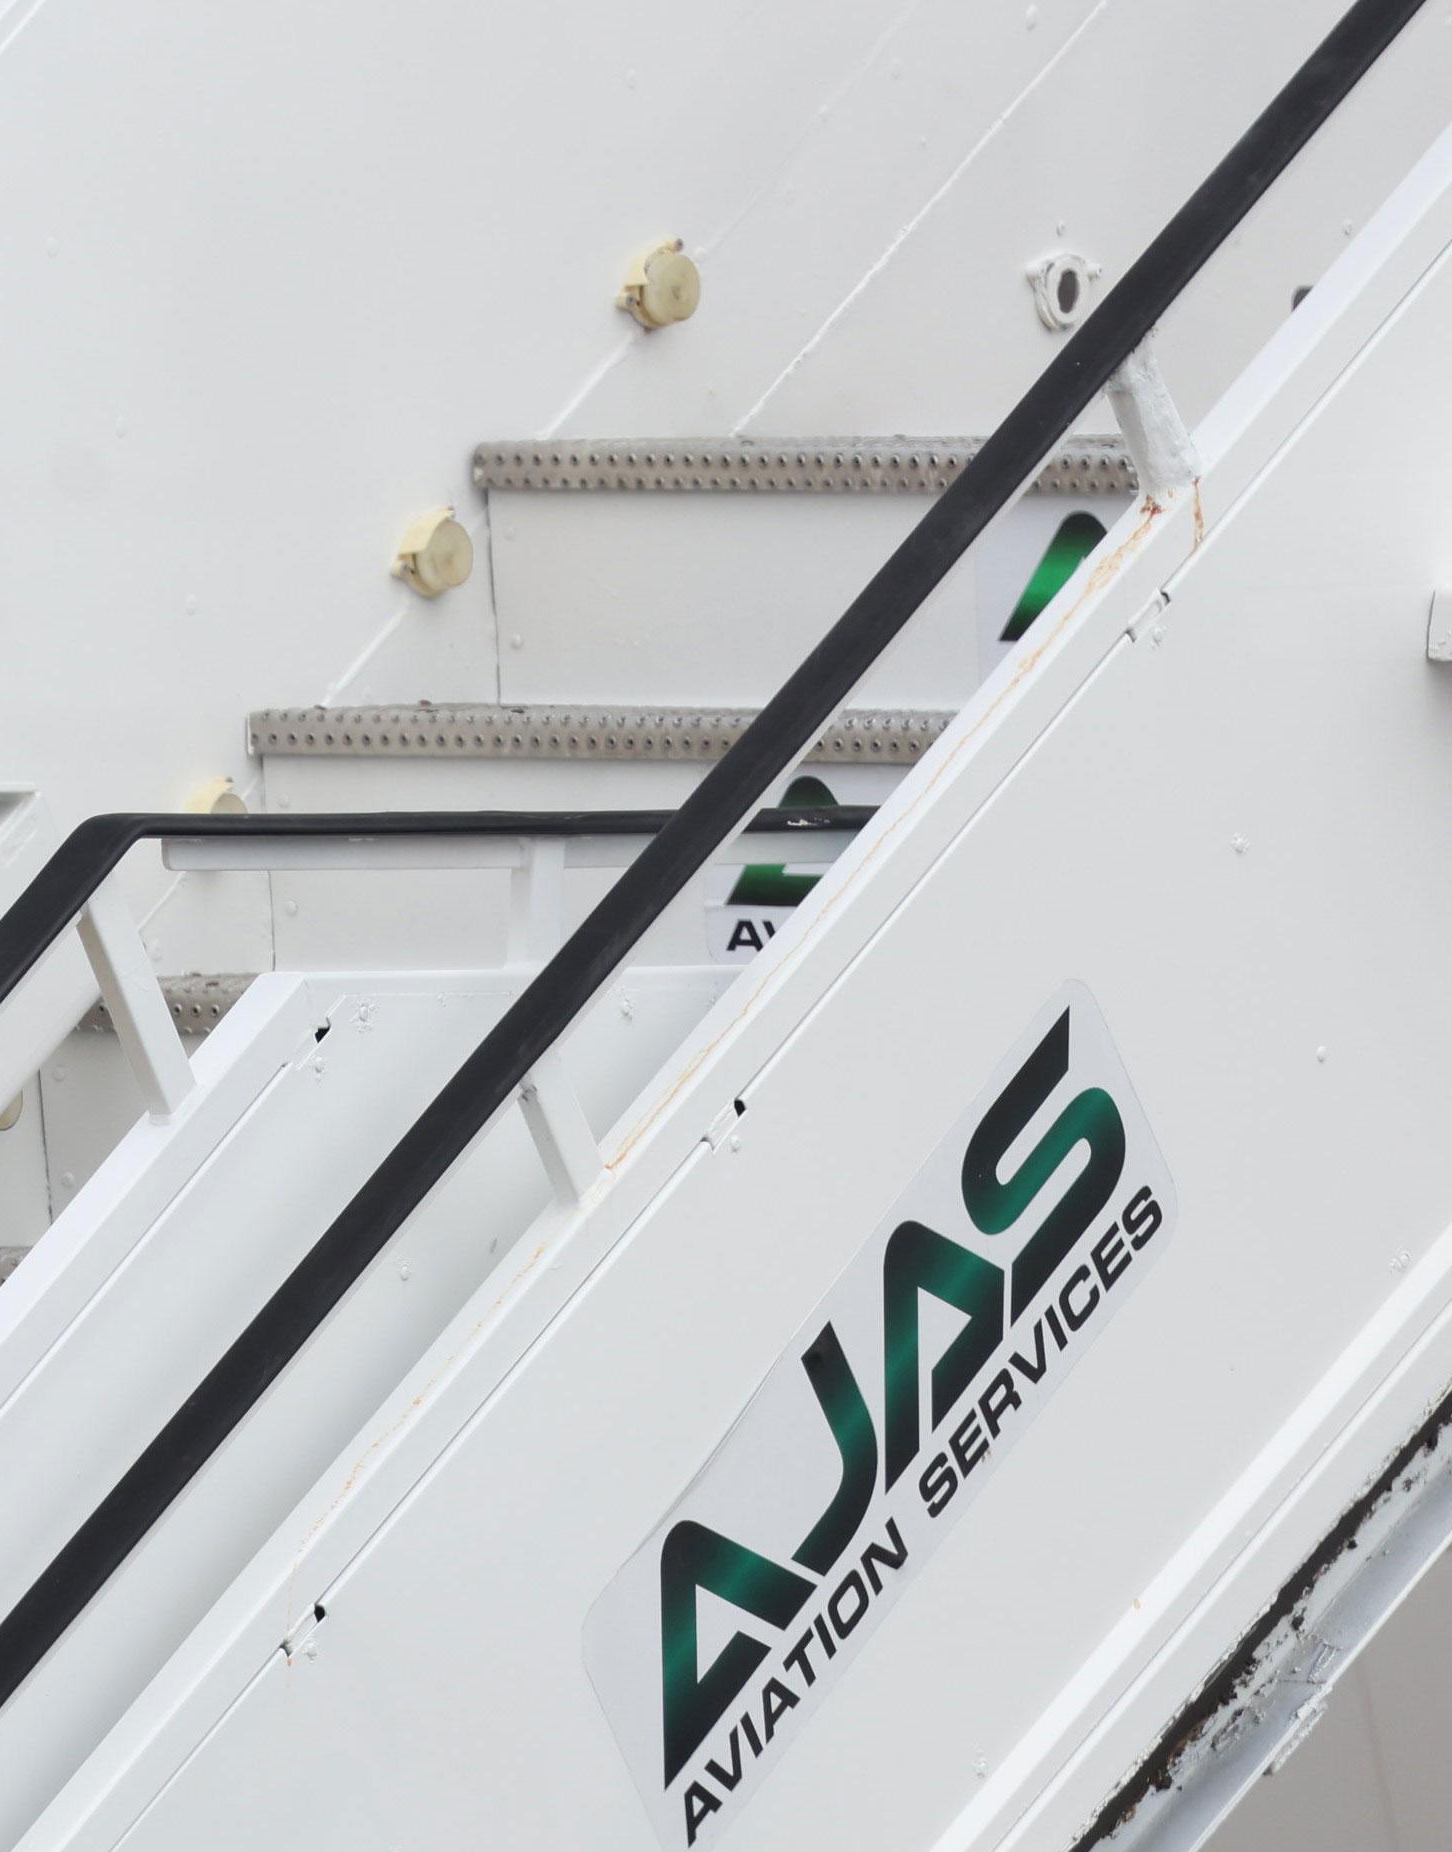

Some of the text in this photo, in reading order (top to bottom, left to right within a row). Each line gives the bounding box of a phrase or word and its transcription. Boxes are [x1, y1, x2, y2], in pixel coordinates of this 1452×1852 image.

[661, 1006, 1125, 1790] AJAS
[685, 1186, 1162, 1847] AVIATION SERVICES
